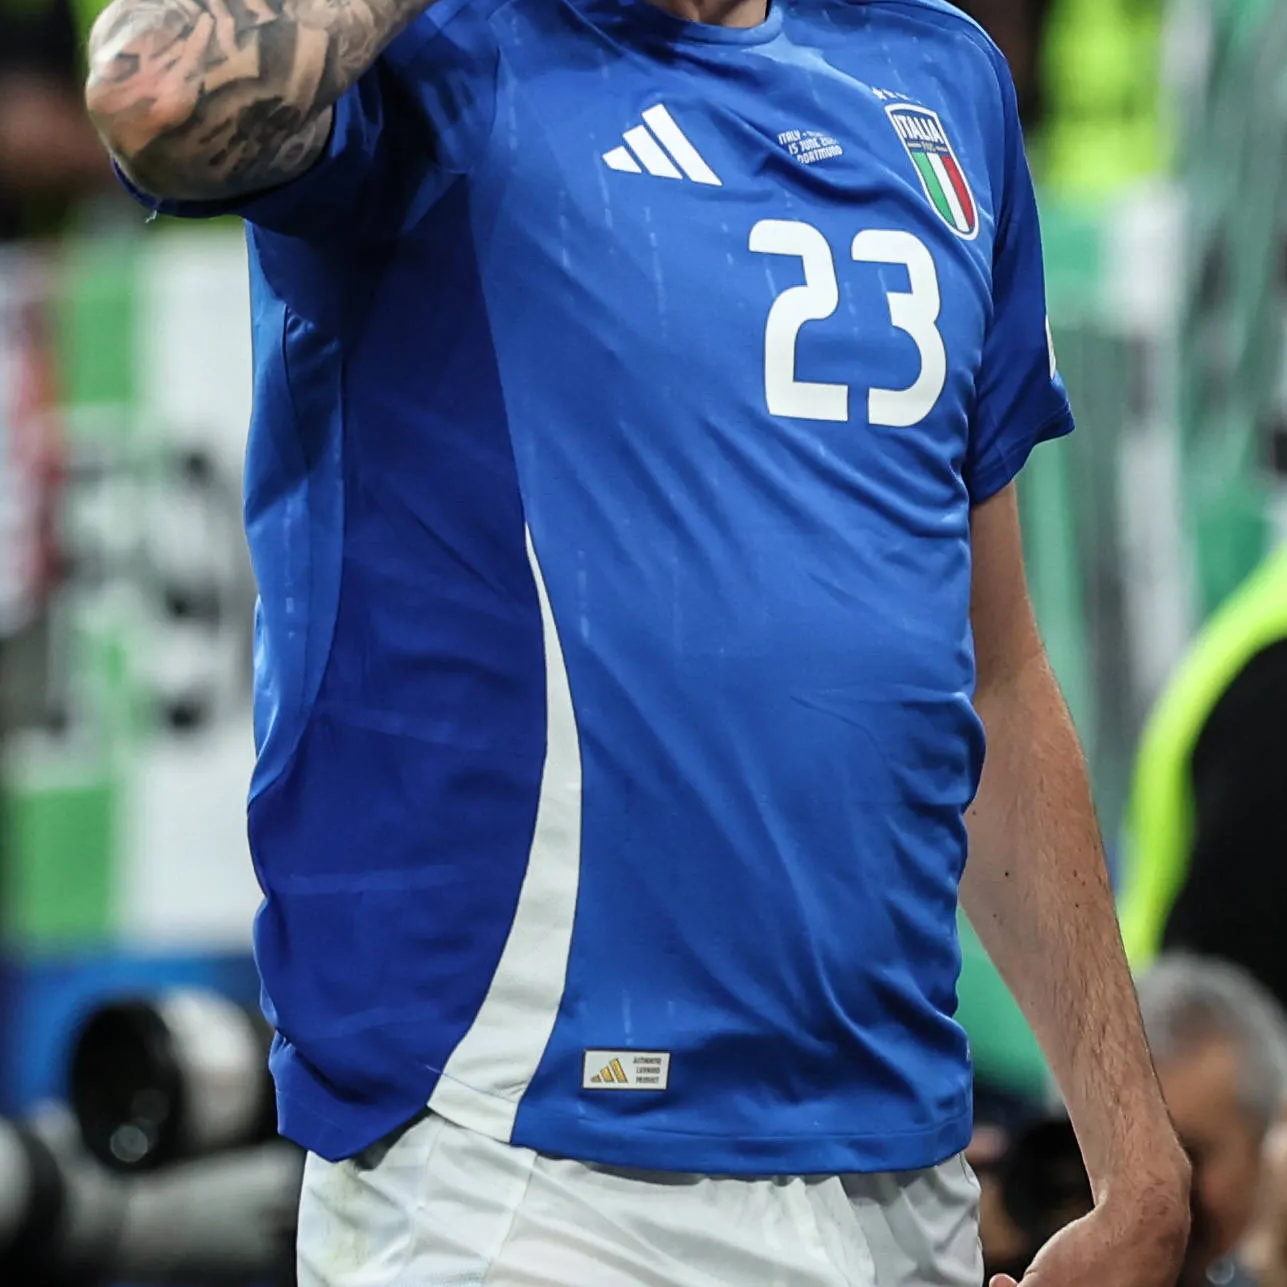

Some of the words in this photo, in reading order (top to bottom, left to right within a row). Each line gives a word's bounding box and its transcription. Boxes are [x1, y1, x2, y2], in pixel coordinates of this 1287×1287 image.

[778, 130, 801, 145] ITALY
[893, 114, 945, 144] ITALIA
[749, 219, 947, 428] 23
